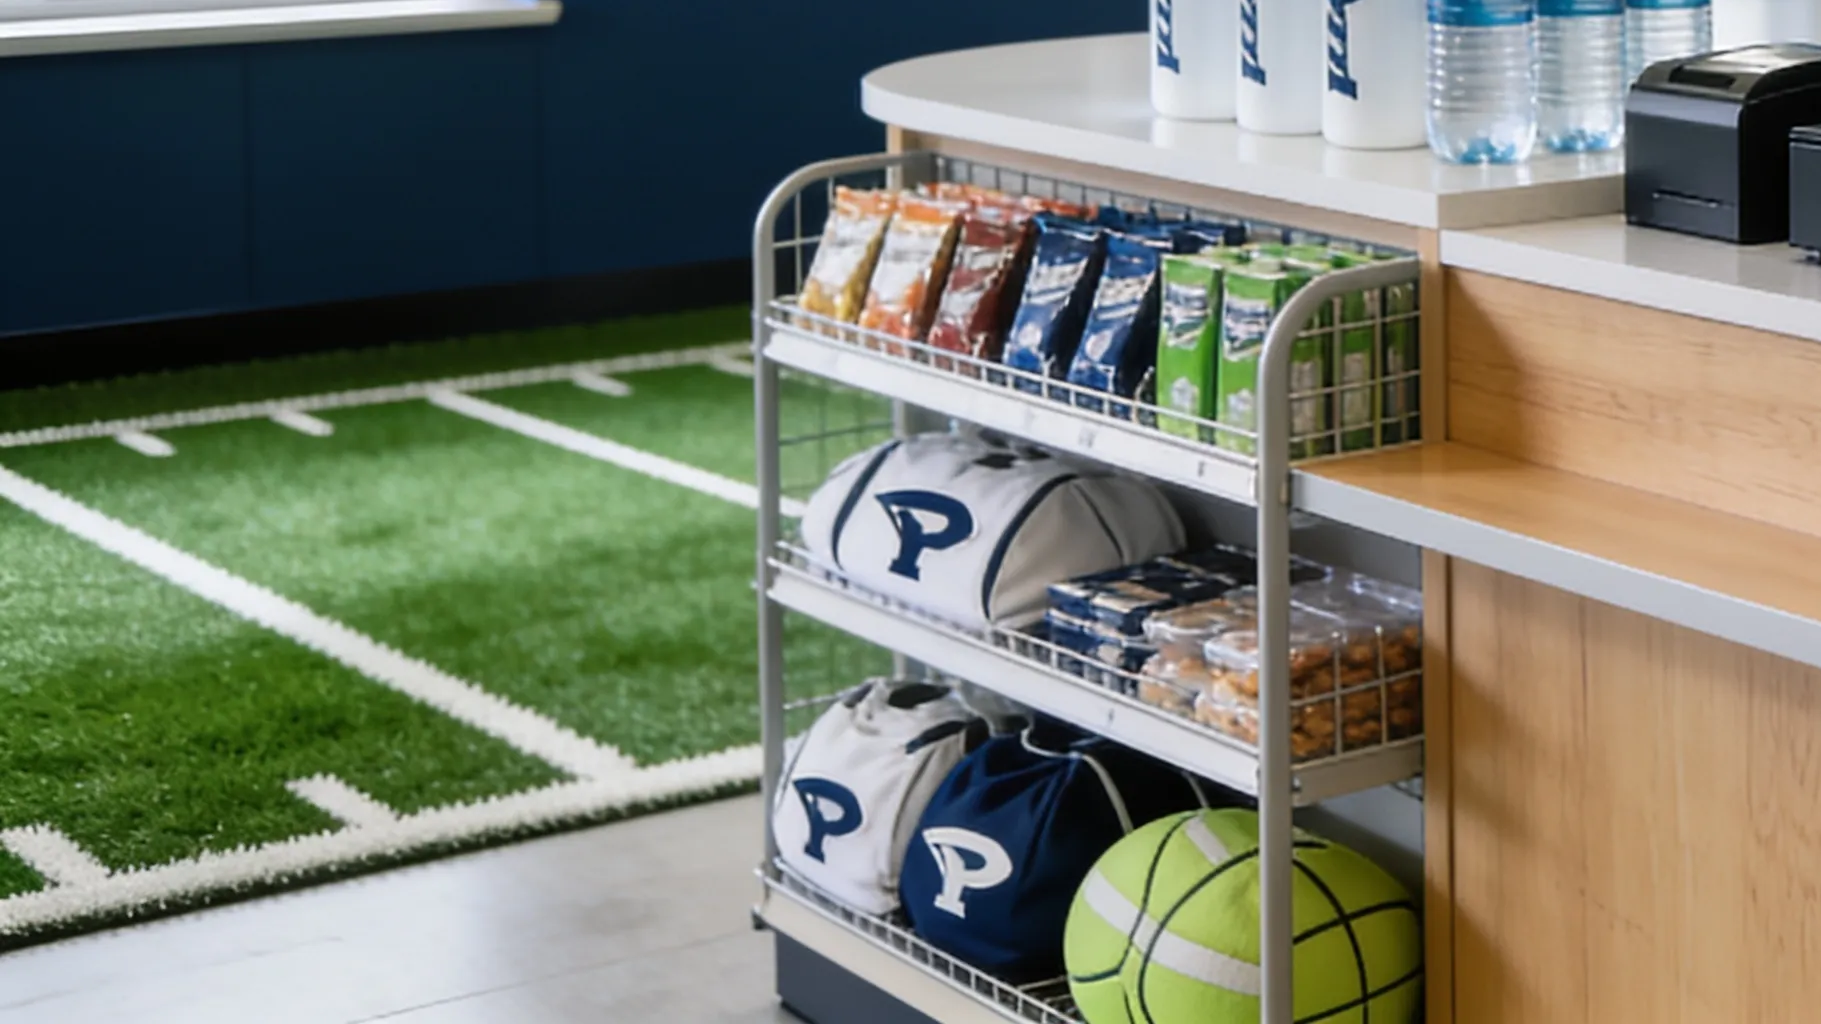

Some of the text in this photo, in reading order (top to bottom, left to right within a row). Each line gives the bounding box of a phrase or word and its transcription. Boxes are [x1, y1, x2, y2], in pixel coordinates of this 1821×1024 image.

[876, 490, 975, 580] P
[793, 778, 863, 863] P
[922, 826, 1014, 919] P
